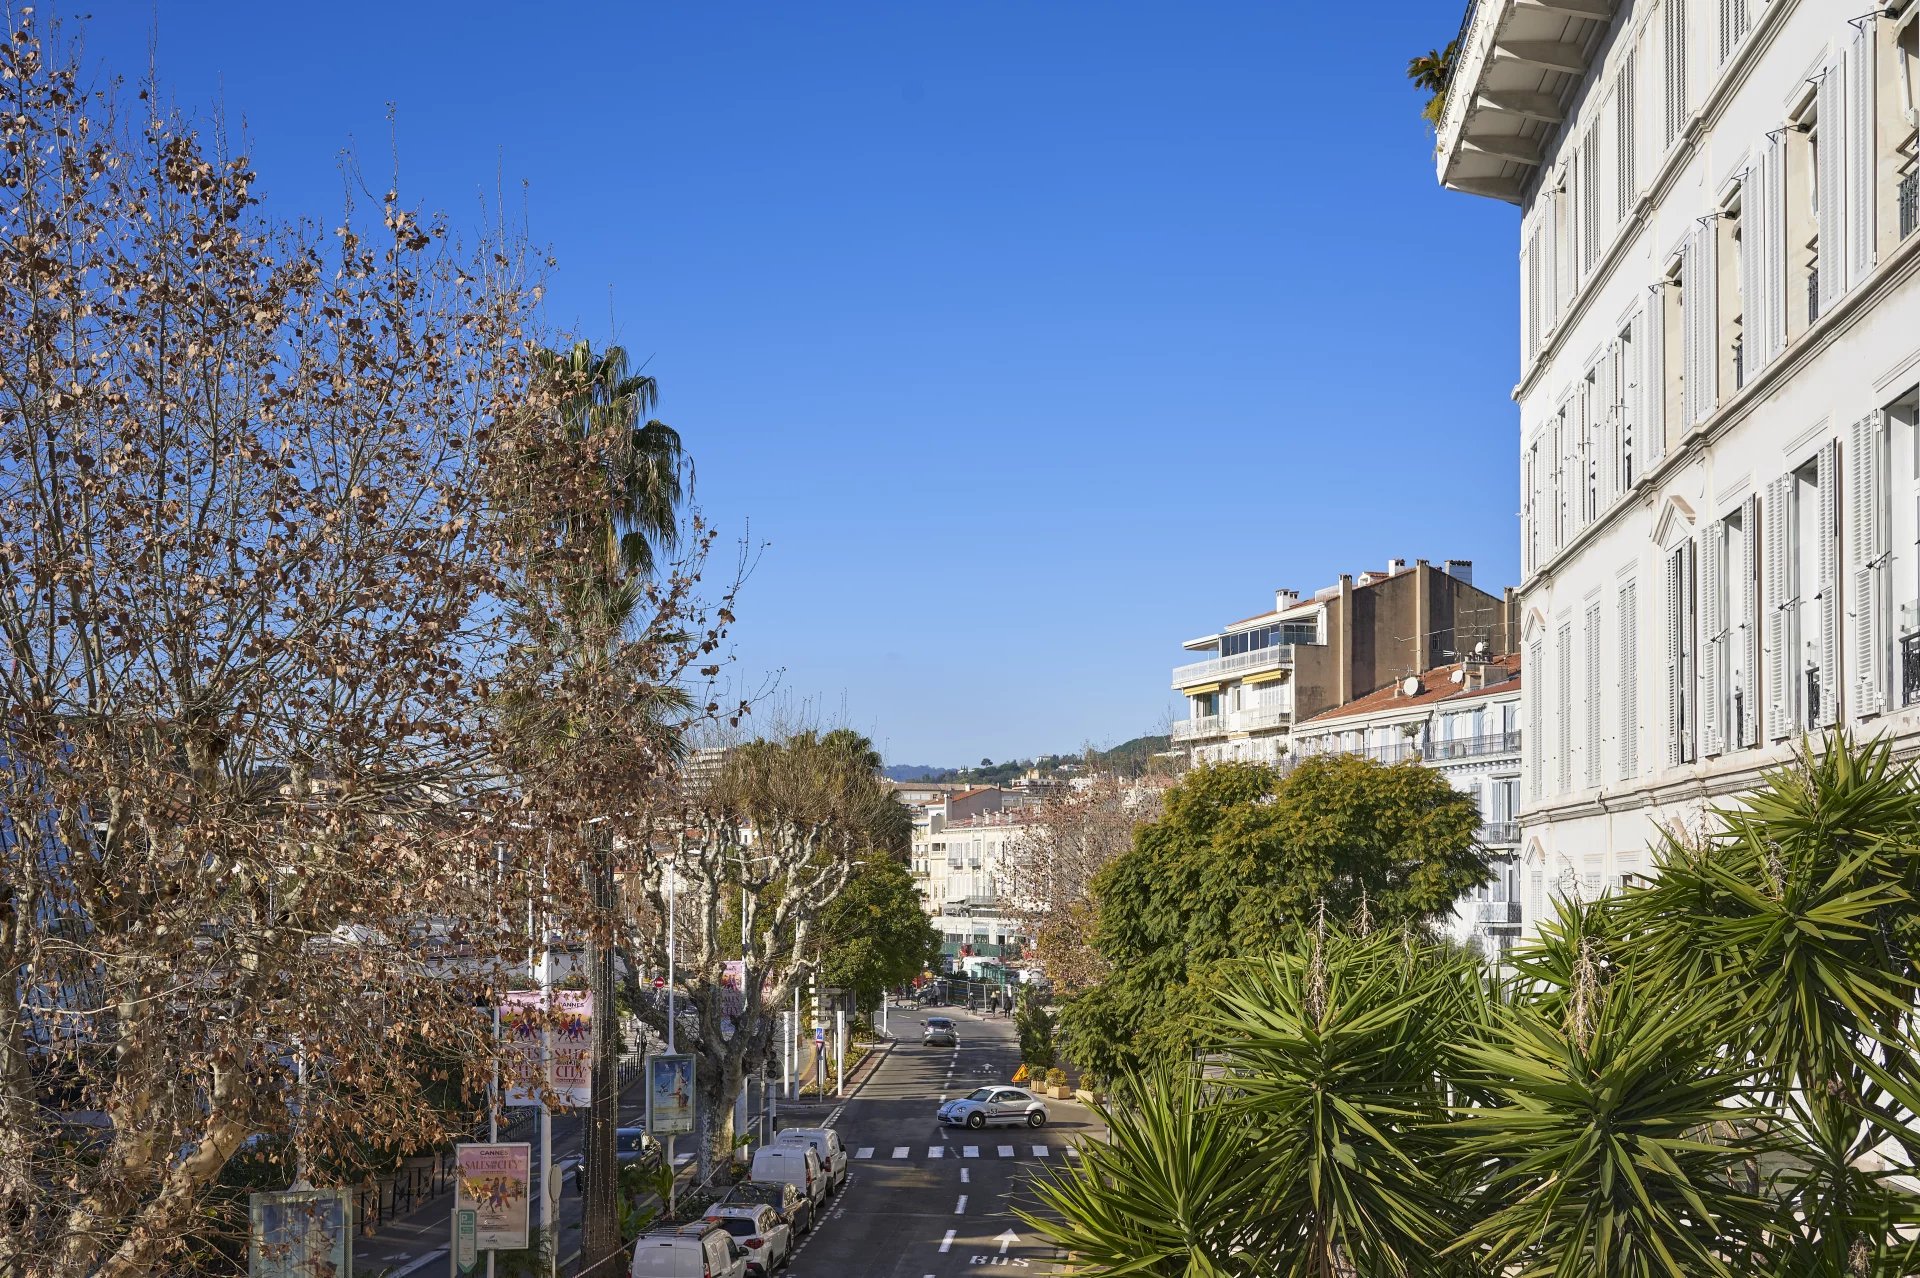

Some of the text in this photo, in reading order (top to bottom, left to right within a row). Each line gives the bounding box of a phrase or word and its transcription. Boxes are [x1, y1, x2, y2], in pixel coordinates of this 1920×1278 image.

[555, 1048, 586, 1060] SALE
[556, 1065, 585, 1078] CITY
[465, 1160, 490, 1170] SALES
[497, 1160, 518, 1170] CITY
[969, 1255, 1031, 1267] BUS
